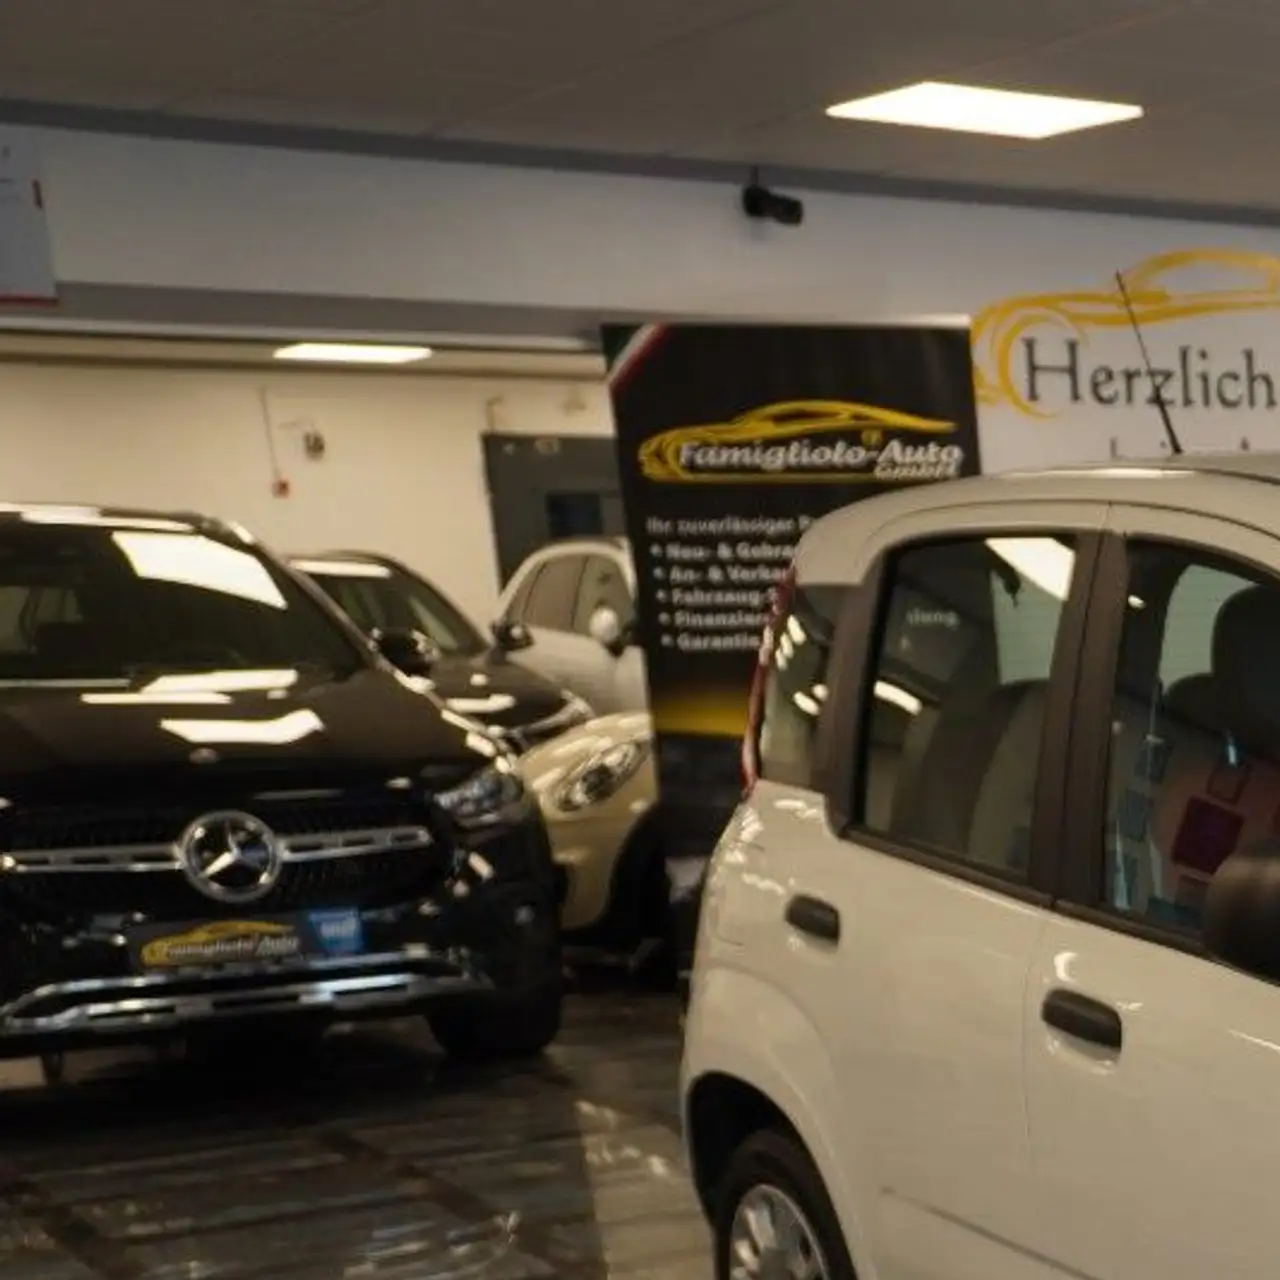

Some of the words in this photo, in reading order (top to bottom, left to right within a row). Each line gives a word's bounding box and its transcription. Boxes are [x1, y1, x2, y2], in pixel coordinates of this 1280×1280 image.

[1021, 336, 1278, 410] Herzlich
[717, 541, 733, 560] &
[708, 564, 724, 582] &
